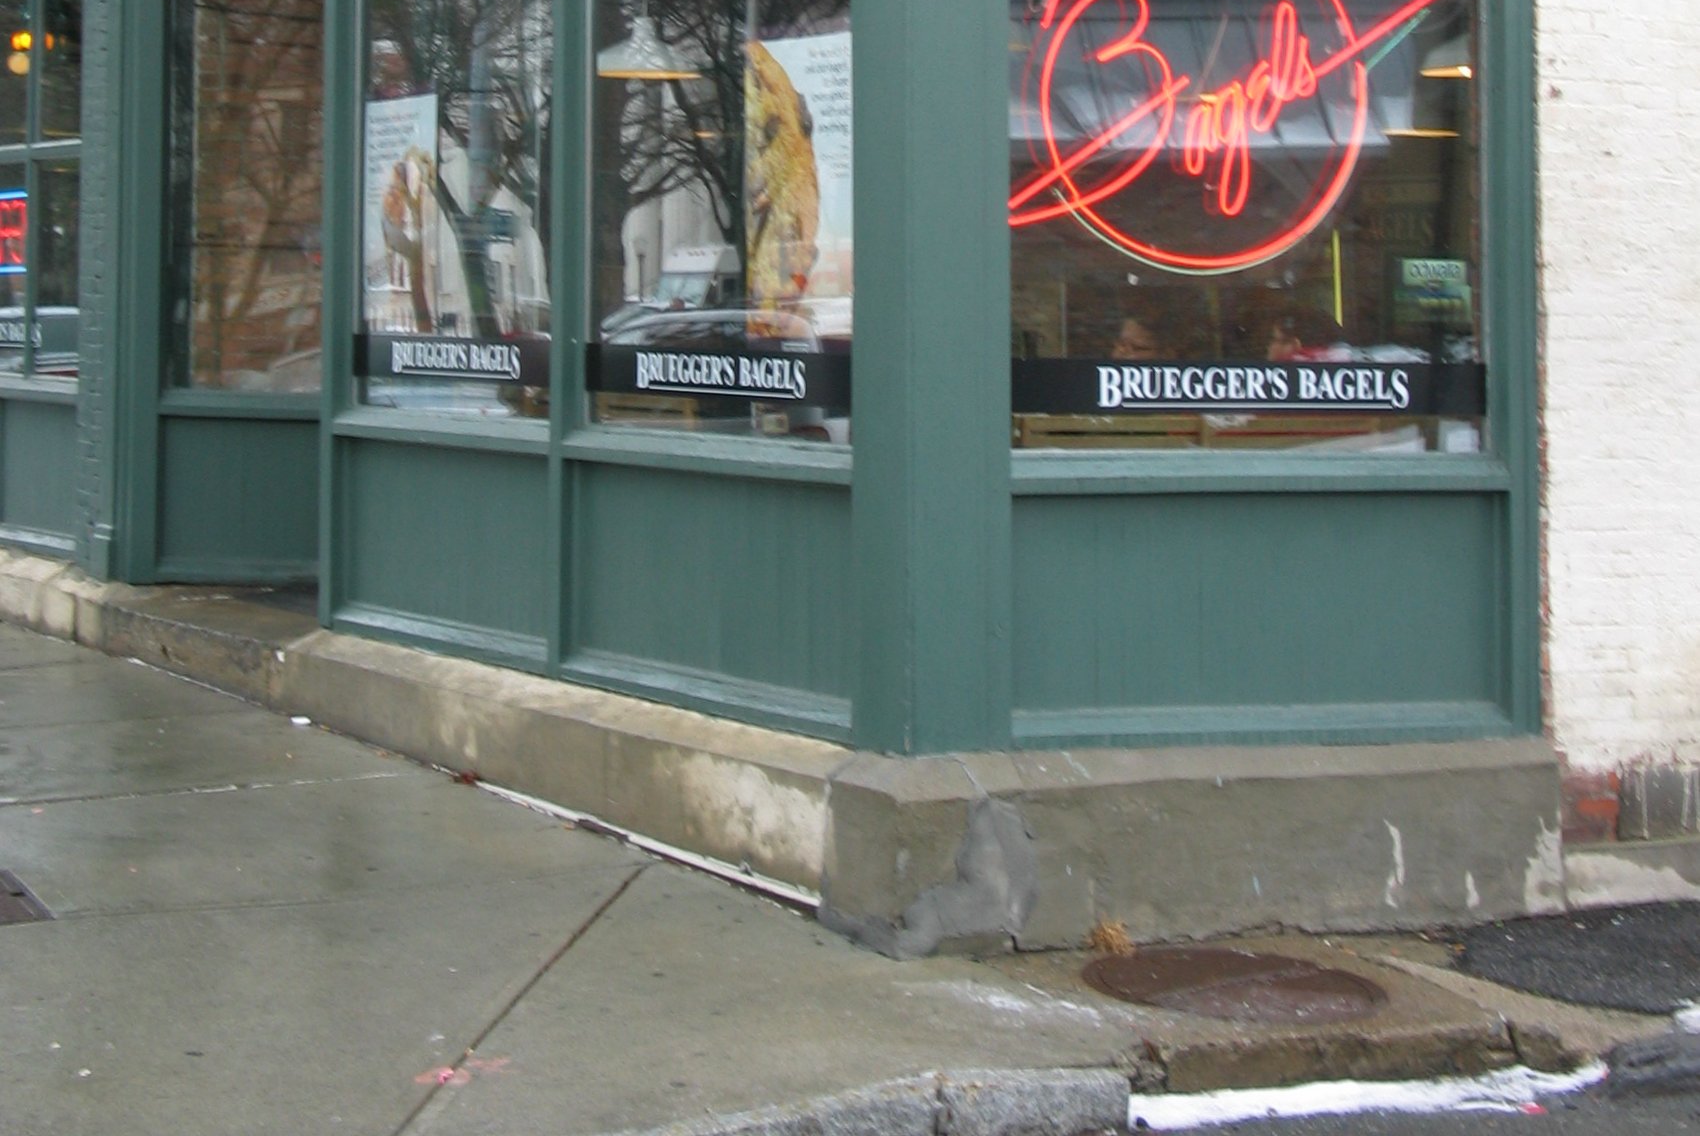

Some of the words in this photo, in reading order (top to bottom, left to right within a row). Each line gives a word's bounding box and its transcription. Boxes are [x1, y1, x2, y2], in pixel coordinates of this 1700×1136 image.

[392, 341, 468, 373] BRUEGGER'S
[469, 344, 521, 380] BAGELS
[635, 351, 735, 390] BRUEGGER'S
[739, 356, 806, 400] BAGELS
[1097, 366, 1290, 408] BRUEGGER'S
[1298, 368, 1411, 409] BAGELS
